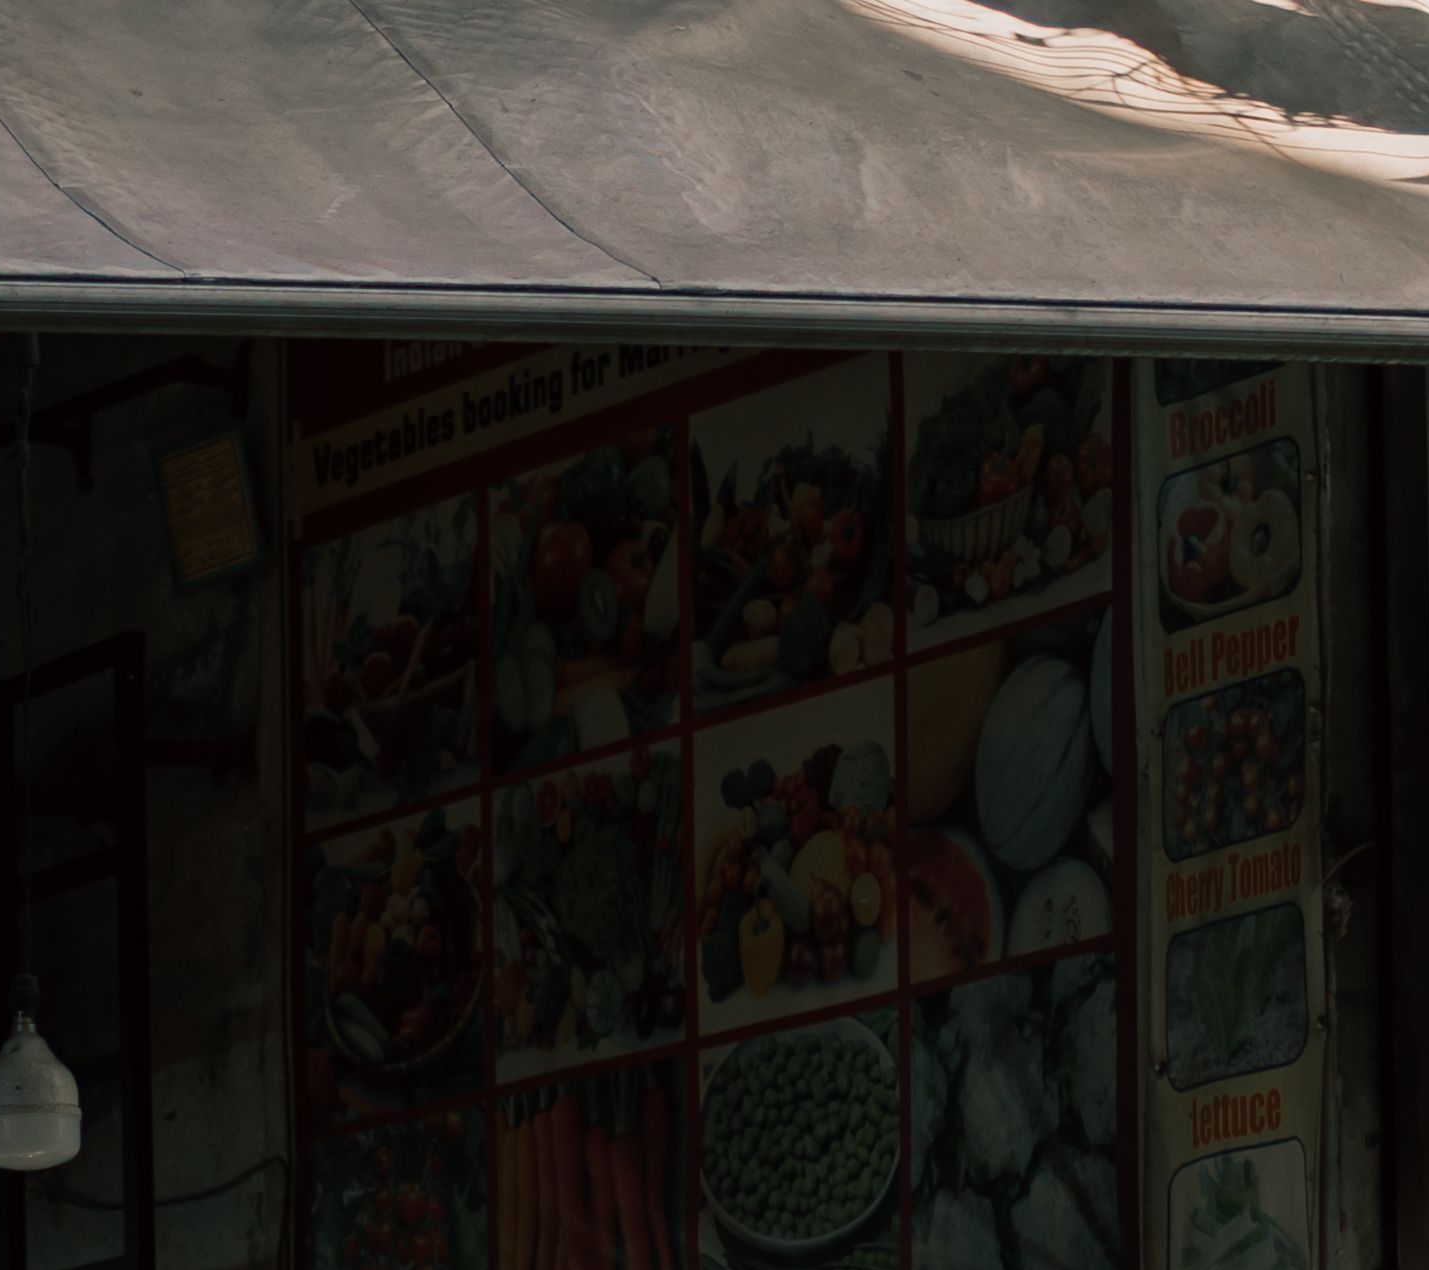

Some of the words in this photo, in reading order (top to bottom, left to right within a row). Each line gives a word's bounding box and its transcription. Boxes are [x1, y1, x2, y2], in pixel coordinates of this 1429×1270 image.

[313, 406, 454, 486] Vegetables
[463, 367, 562, 435] booking
[571, 350, 610, 396] for
[1170, 380, 1277, 459] Broccoli
[1163, 640, 1204, 696] Bell
[1211, 615, 1300, 684] Pepper
[1165, 866, 1224, 923] Cherry
[1227, 842, 1301, 902] Tomato
